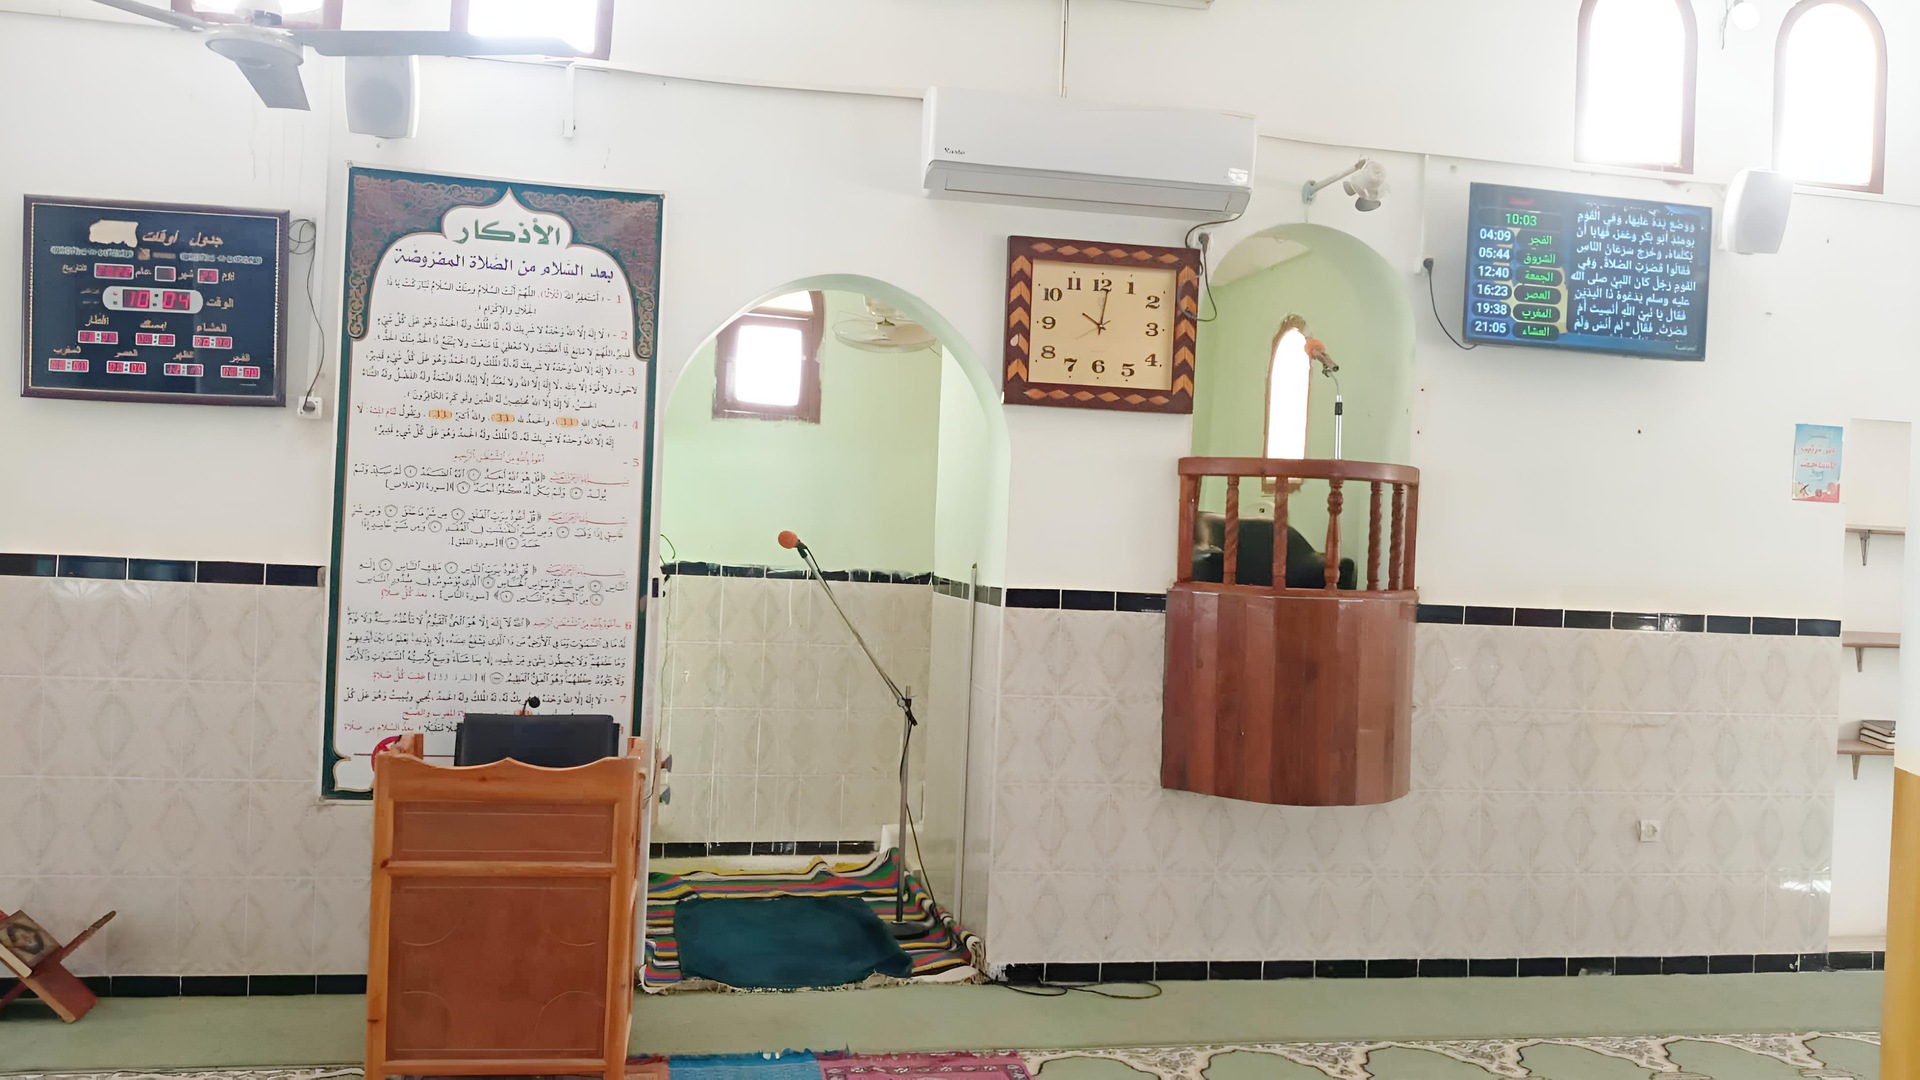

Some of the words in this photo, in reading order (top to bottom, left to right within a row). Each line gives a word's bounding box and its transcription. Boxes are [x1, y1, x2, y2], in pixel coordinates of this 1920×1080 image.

[1505, 213, 1537, 226] 10:03
[452, 217, 560, 246] الأذكار
[1480, 228, 1511, 241] 04:09
[1528, 235, 1552, 246] الفجر
[1478, 246, 1510, 260] 05:44
[590, 268, 614, 284] بعد
[1478, 265, 1509, 279] 12:40
[1067, 277, 1082, 290] 11
[1093, 278, 1112, 292] 12
[1126, 281, 1136, 295] 1
[1477, 283, 1508, 297] 16:23
[126, 289, 191, 309] 10:04
[1042, 287, 1063, 302] 10
[1524, 289, 1551, 301] العصر
[1145, 295, 1160, 309] 2
[1476, 302, 1507, 315] 19:38
[1521, 308, 1552, 320] المغرب
[1041, 316, 1056, 329] 9
[1145, 322, 1159, 337] 3
[1474, 320, 1506, 334] 21:05
[1522, 325, 1550, 337] العشاء
[1040, 345, 1056, 359] 8
[1063, 357, 1078, 372] 7
[1091, 359, 1105, 374] 6
[1144, 353, 1158, 367] 4
[1121, 363, 1135, 377] 5
